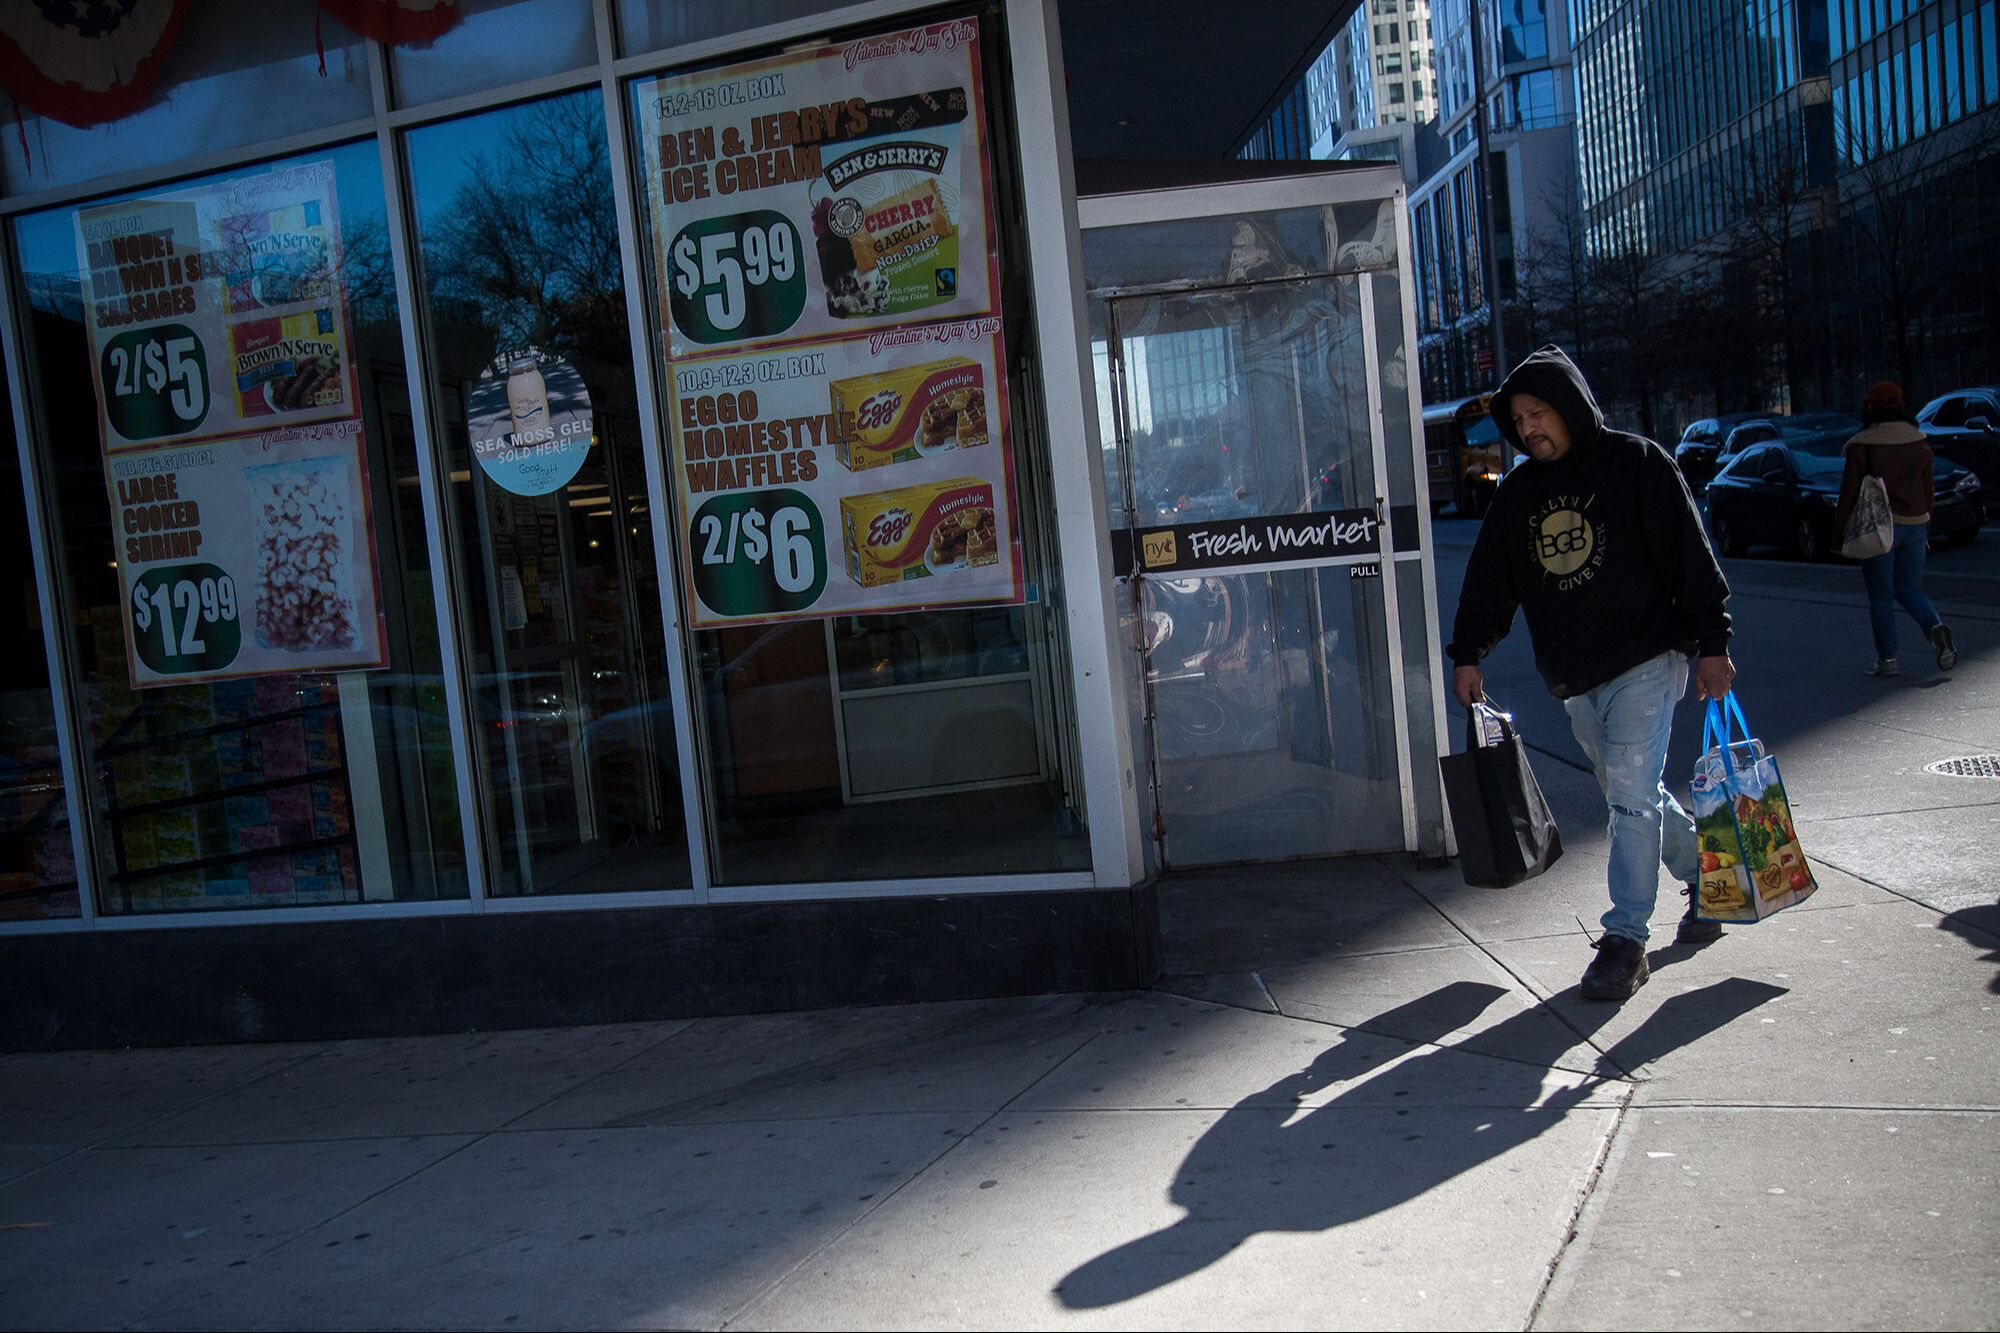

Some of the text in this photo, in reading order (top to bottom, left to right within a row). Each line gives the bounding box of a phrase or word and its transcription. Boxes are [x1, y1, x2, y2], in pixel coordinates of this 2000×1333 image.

[843, 21, 977, 71] Valentine's Day Sale
[653, 73, 786, 119] 15.2-16 OZ. BOX
[871, 107, 895, 119] NEW
[659, 97, 869, 169] BEN & JERRY'S
[662, 144, 823, 205] ICE CREAM
[121, 215, 145, 234] BOX
[864, 194, 935, 234] CHERRY
[88, 228, 174, 270] BANQUET
[283, 231, 322, 249] Serve
[873, 220, 927, 253] GARCIA
[876, 235, 940, 270] Non-Dairy
[92, 262, 166, 299] BROWN
[96, 286, 197, 328] SAUSAGES
[295, 339, 333, 357] Serve
[869, 317, 1000, 356] Valentine's Day Sale
[110, 336, 205, 421] 2/$5
[676, 353, 826, 393] 10.9-12.3 OZ. BOX
[928, 374, 975, 396] Homestyle
[680, 390, 759, 429] EGGO
[857, 395, 902, 430] Eggo
[261, 420, 362, 451] Valentine's Day Sale
[475, 435, 506, 454] SEA
[510, 427, 555, 447] MOSS
[560, 419, 592, 436] GEL
[498, 437, 572, 464] SOLD HERE!
[684, 411, 859, 461] HOMESTYLE
[686, 450, 818, 493] WAFFLES
[854, 455, 865, 465] 10
[118, 473, 178, 506] LARGE
[939, 494, 984, 516] Homestyle
[124, 501, 200, 535] COOKED
[866, 512, 913, 546] Eggo
[126, 530, 203, 564] SHRIMP
[700, 506, 815, 593] 2/$6
[1188, 515, 1377, 559] Fresh Market
[1541, 517, 1587, 558] BGB
[1351, 565, 1379, 577] PULL
[1558, 522, 1606, 591] GIVE BACK
[865, 572, 876, 581] 10
